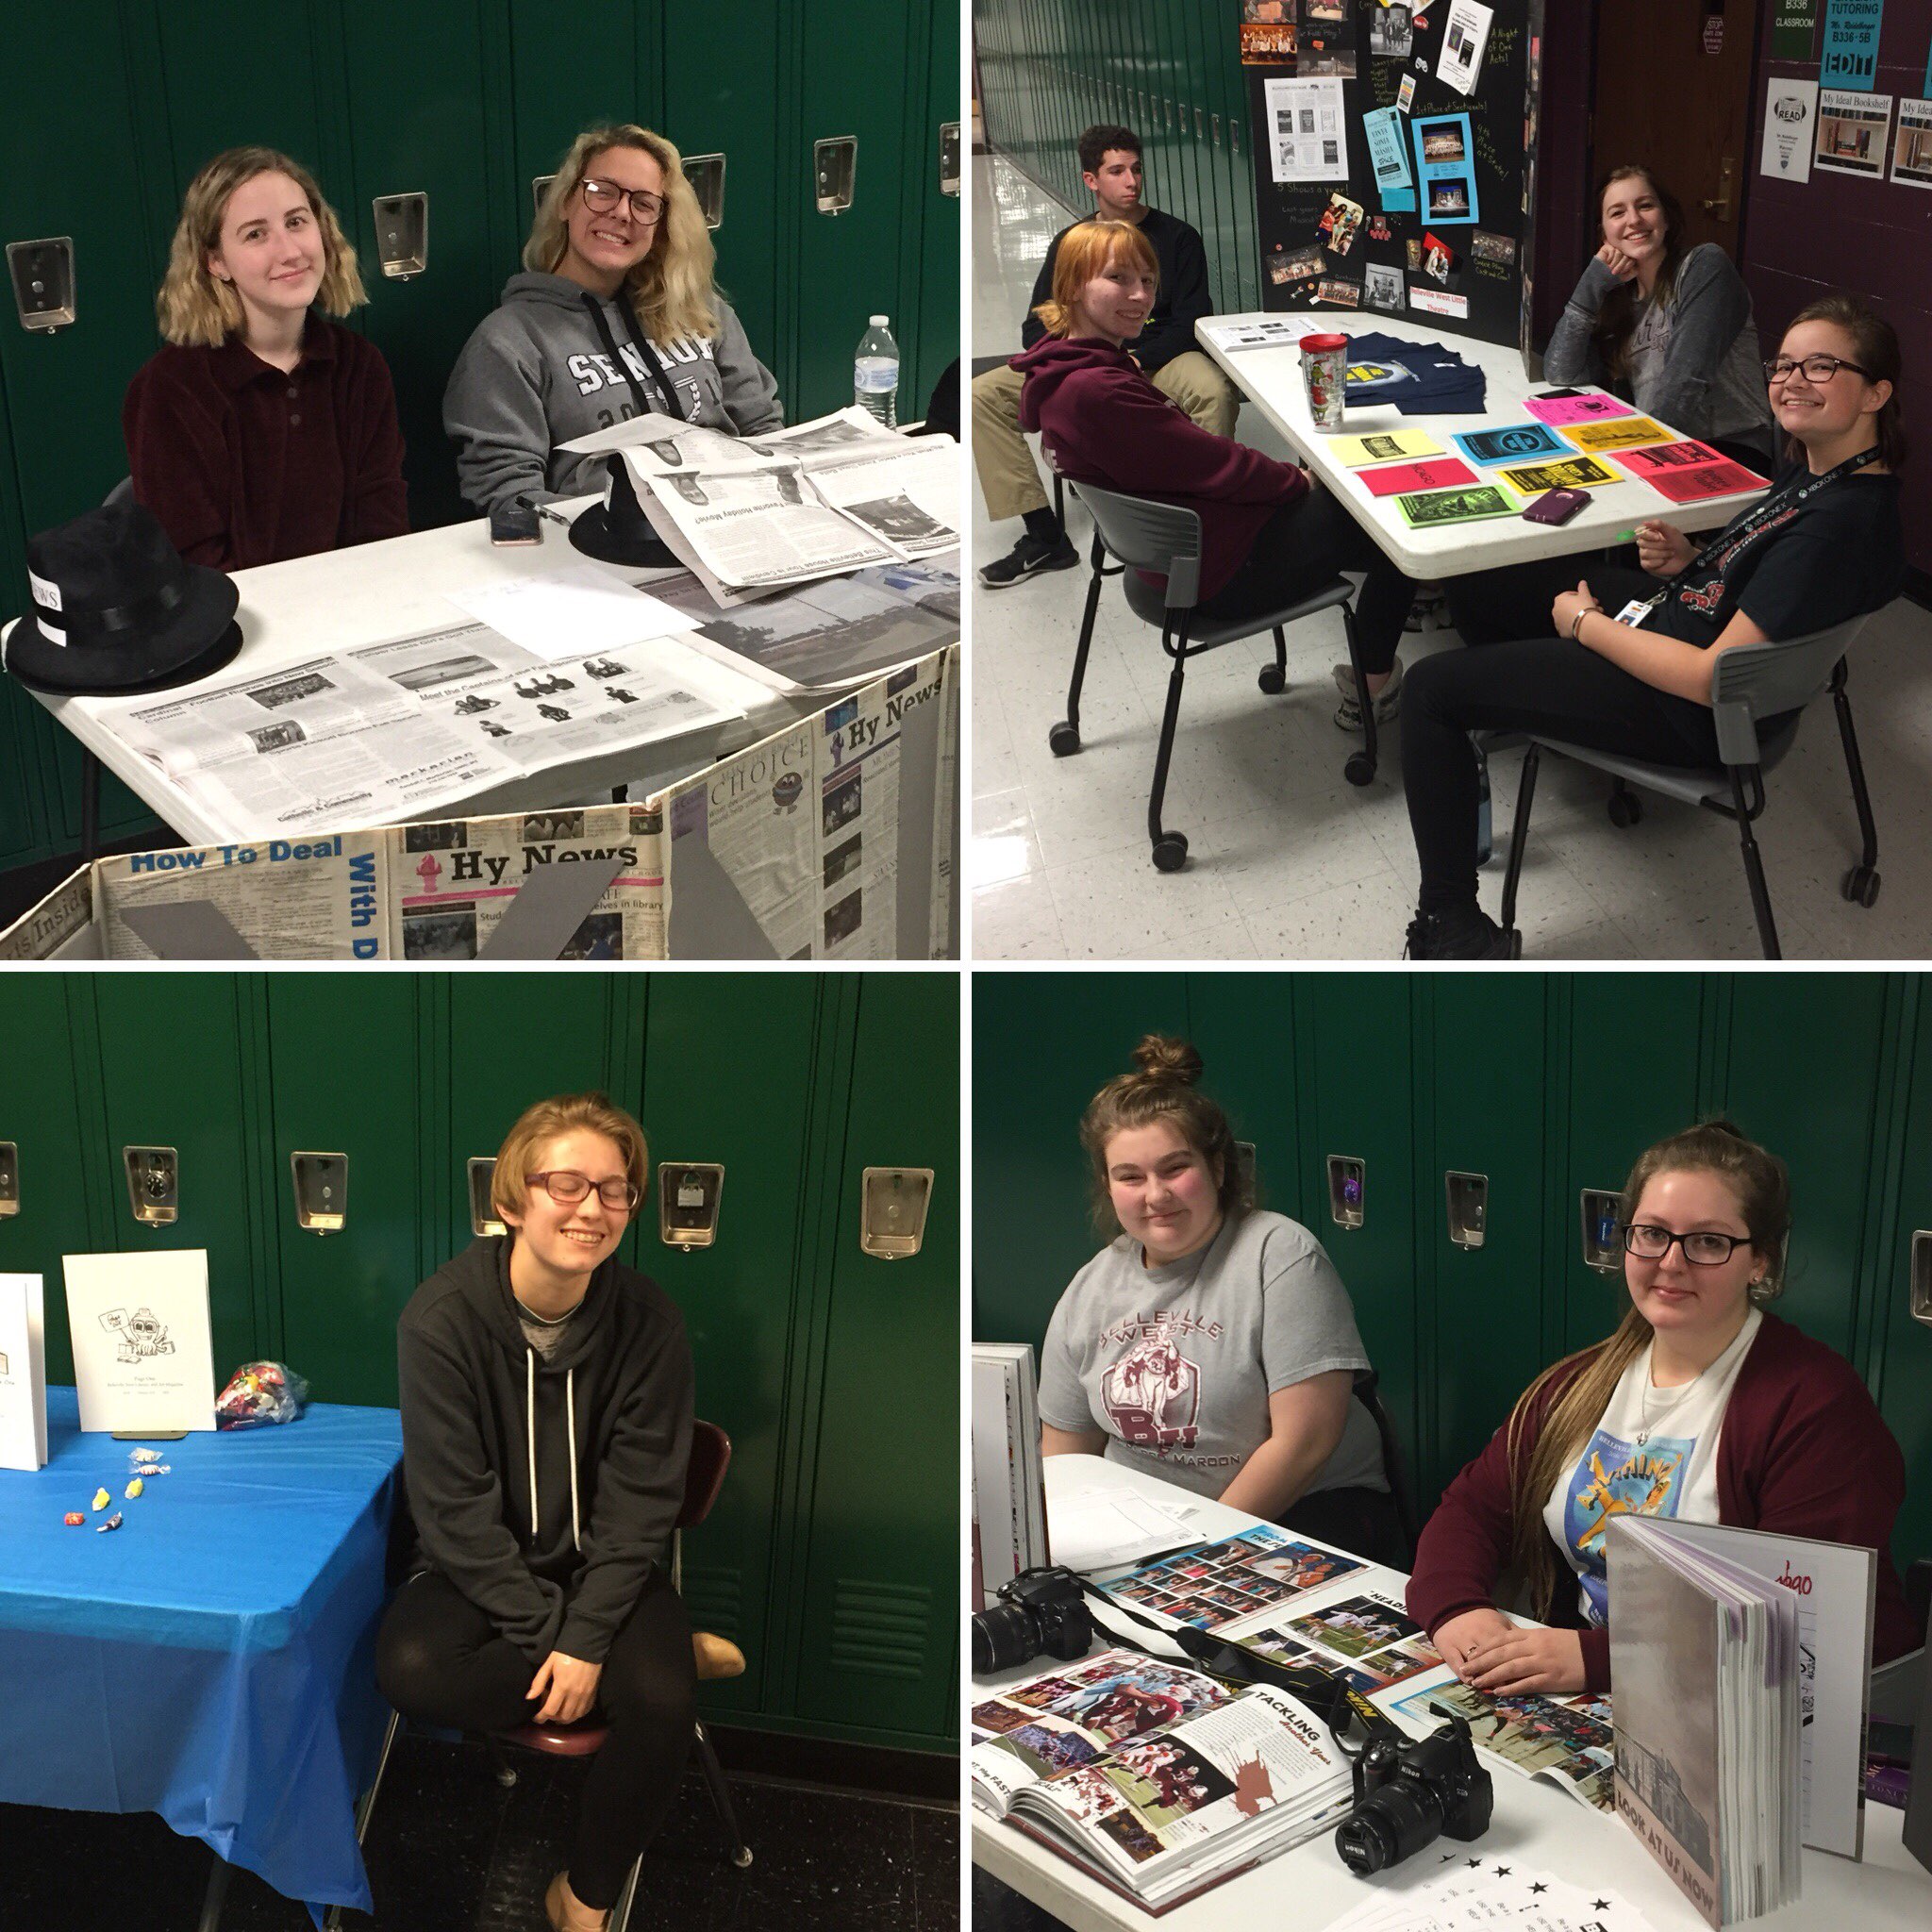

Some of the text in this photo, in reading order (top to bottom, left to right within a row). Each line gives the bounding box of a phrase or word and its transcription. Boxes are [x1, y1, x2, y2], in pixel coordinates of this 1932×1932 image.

[1831, 3, 1878, 14] TUTORING
[1775, 18, 1815, 27] CLASSROOM
[1824, 93, 1890, 109] My Ideal Bookshelf
[1903, 103, 1915, 114] My
[1778, 109, 1802, 123] READ
[1436, 291, 1451, 302] West
[1452, 294, 1466, 305] Little
[1427, 304, 1449, 315] Theatre
[1807, 478, 1825, 492] XBOX
[1825, 473, 1839, 483] ONE
[695, 502, 785, 525] Favorite Holiday Movie?
[1753, 514, 1769, 527] XBOX
[1768, 507, 1782, 518] ONE
[420, 690, 442, 702] Meet
[849, 676, 942, 750] Hy News
[130, 836, 342, 874] How To Deal
[450, 844, 638, 885] Hy News
[348, 852, 376, 927] With
[633, 899, 663, 911] library
[1173, 1454, 1241, 1468] MAROON
[1255, 1691, 1321, 1741] TACKLING
[1279, 1720, 1310, 1748] Another
[1401, 1766, 1421, 1778] Nikon
[1345, 1845, 1365, 1856] Nikon
[1618, 1790, 1713, 1912] LOOK AT US NOW
